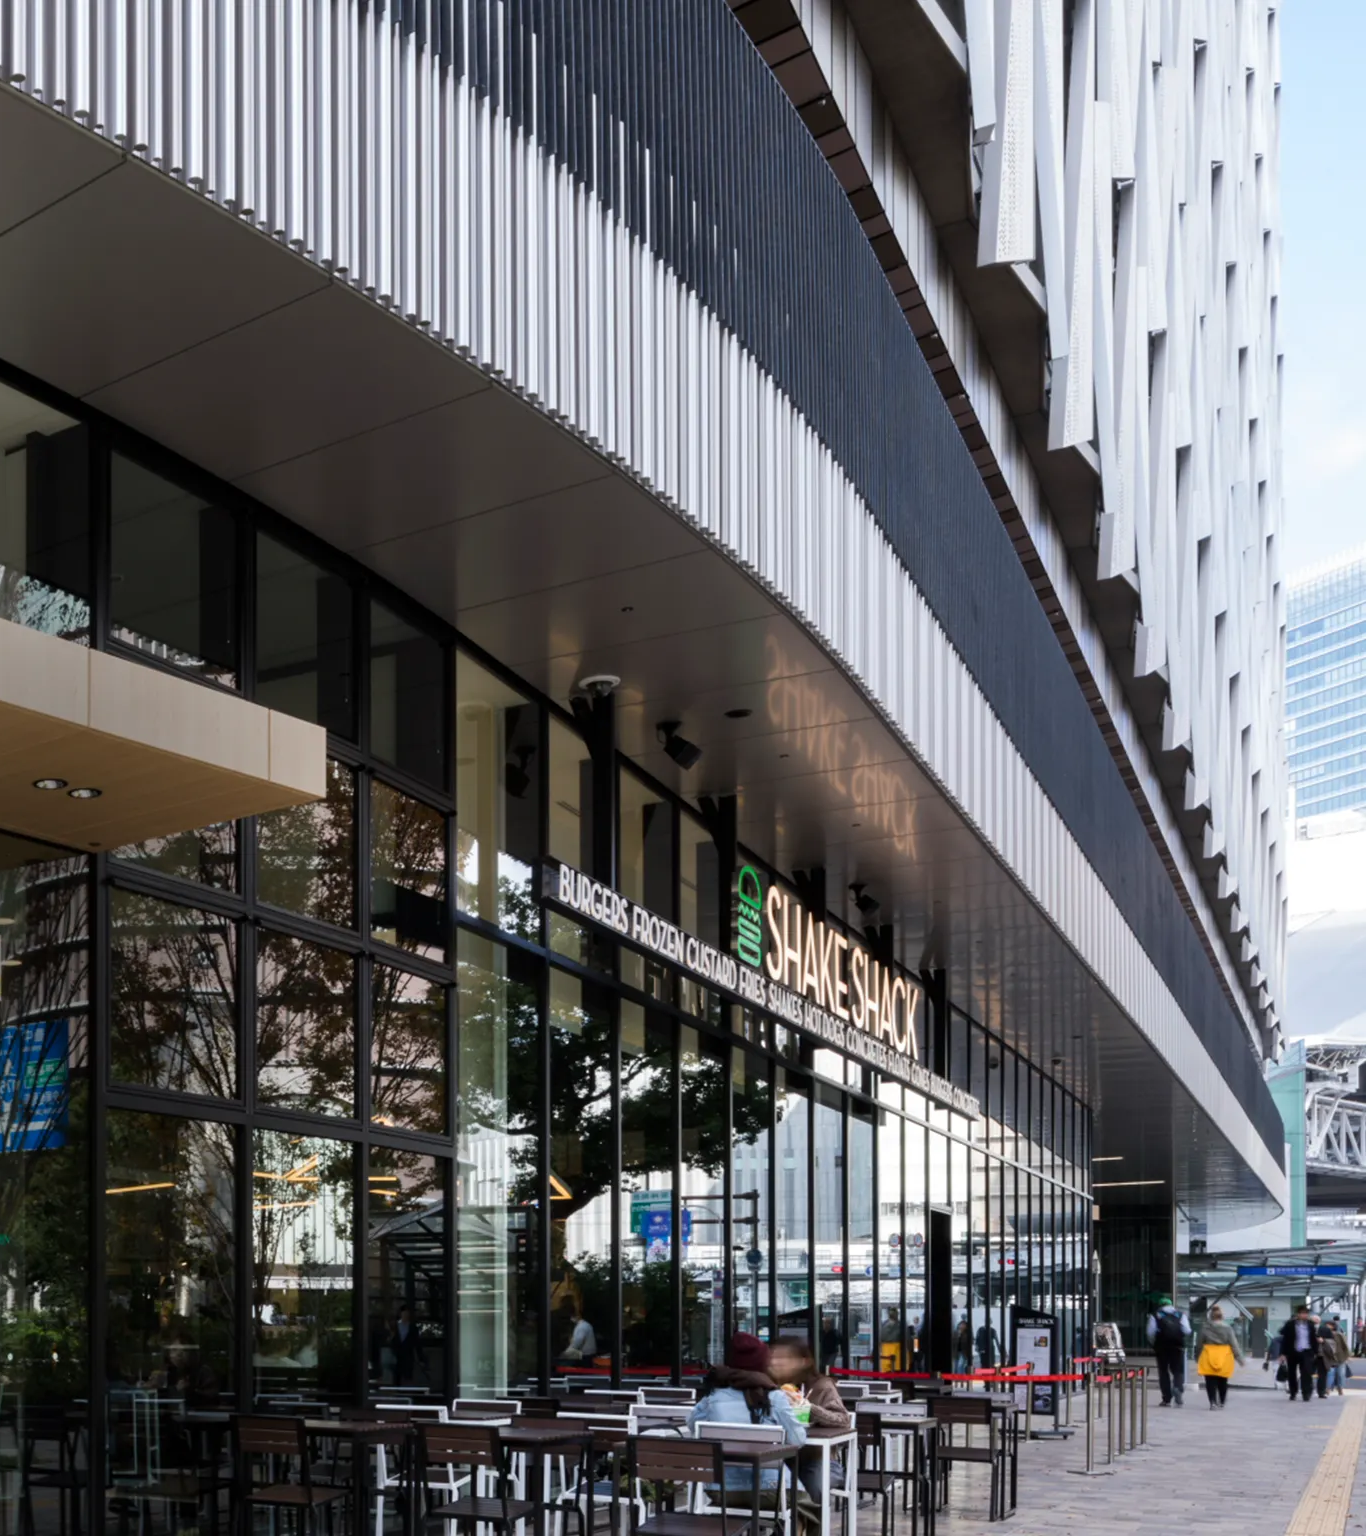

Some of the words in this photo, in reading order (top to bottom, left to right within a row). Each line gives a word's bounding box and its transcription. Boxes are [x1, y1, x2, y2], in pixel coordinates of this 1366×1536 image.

[559, 863, 629, 934] BURGERS
[632, 905, 684, 963] FROZEN
[686, 937, 737, 990] CUSTARD
[739, 966, 766, 1006] FRIES
[768, 983, 803, 1025] SHAKES
[766, 885, 850, 1021] SHAKE
[851, 946, 918, 1061] SHACK
